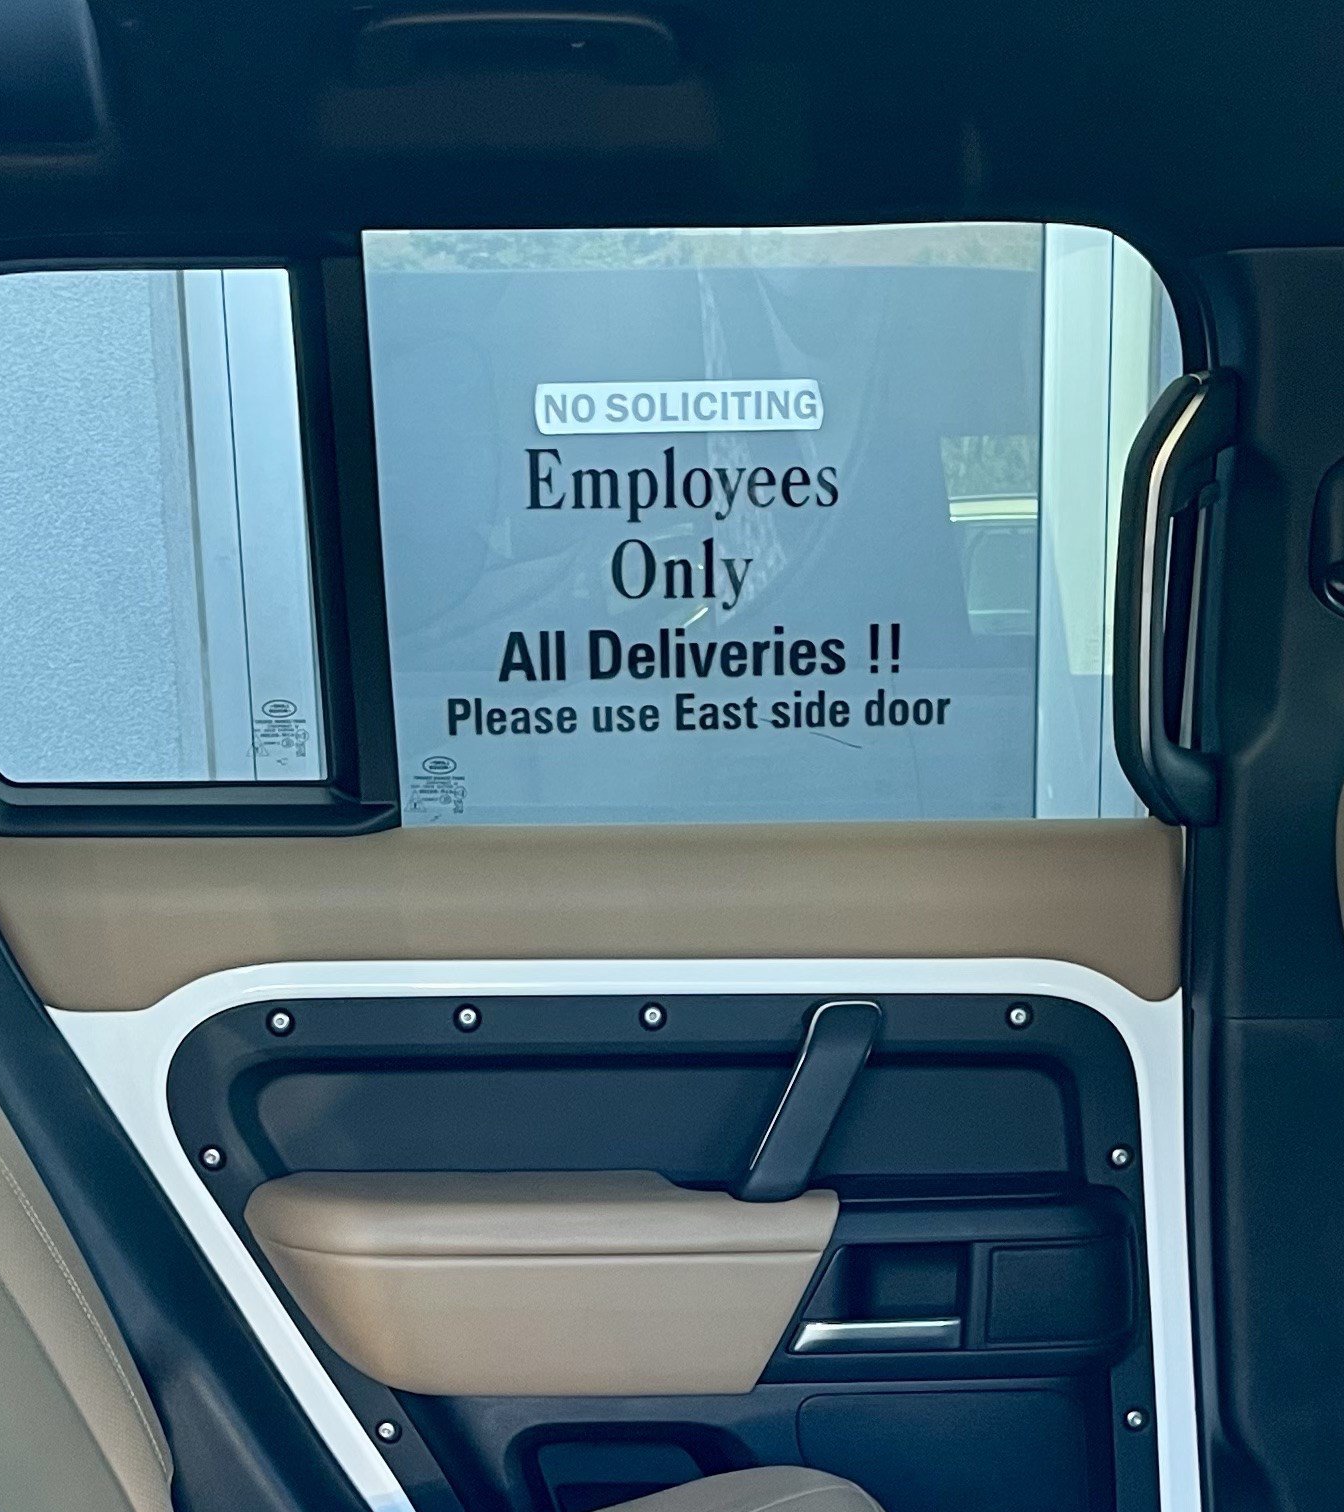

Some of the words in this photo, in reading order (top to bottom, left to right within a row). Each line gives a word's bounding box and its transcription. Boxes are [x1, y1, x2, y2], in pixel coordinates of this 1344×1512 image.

[544, 394, 595, 423] NO
[605, 390, 817, 422] SOLICITING
[525, 446, 838, 523] Employees
[611, 537, 753, 611] Only
[499, 631, 566, 682] All
[589, 626, 846, 680] Deliveries
[870, 623, 900, 674] !!
[448, 698, 577, 736] Please
[593, 705, 659, 733] use
[676, 693, 758, 731] East
[768, 690, 850, 729] side
[865, 689, 950, 726] door
